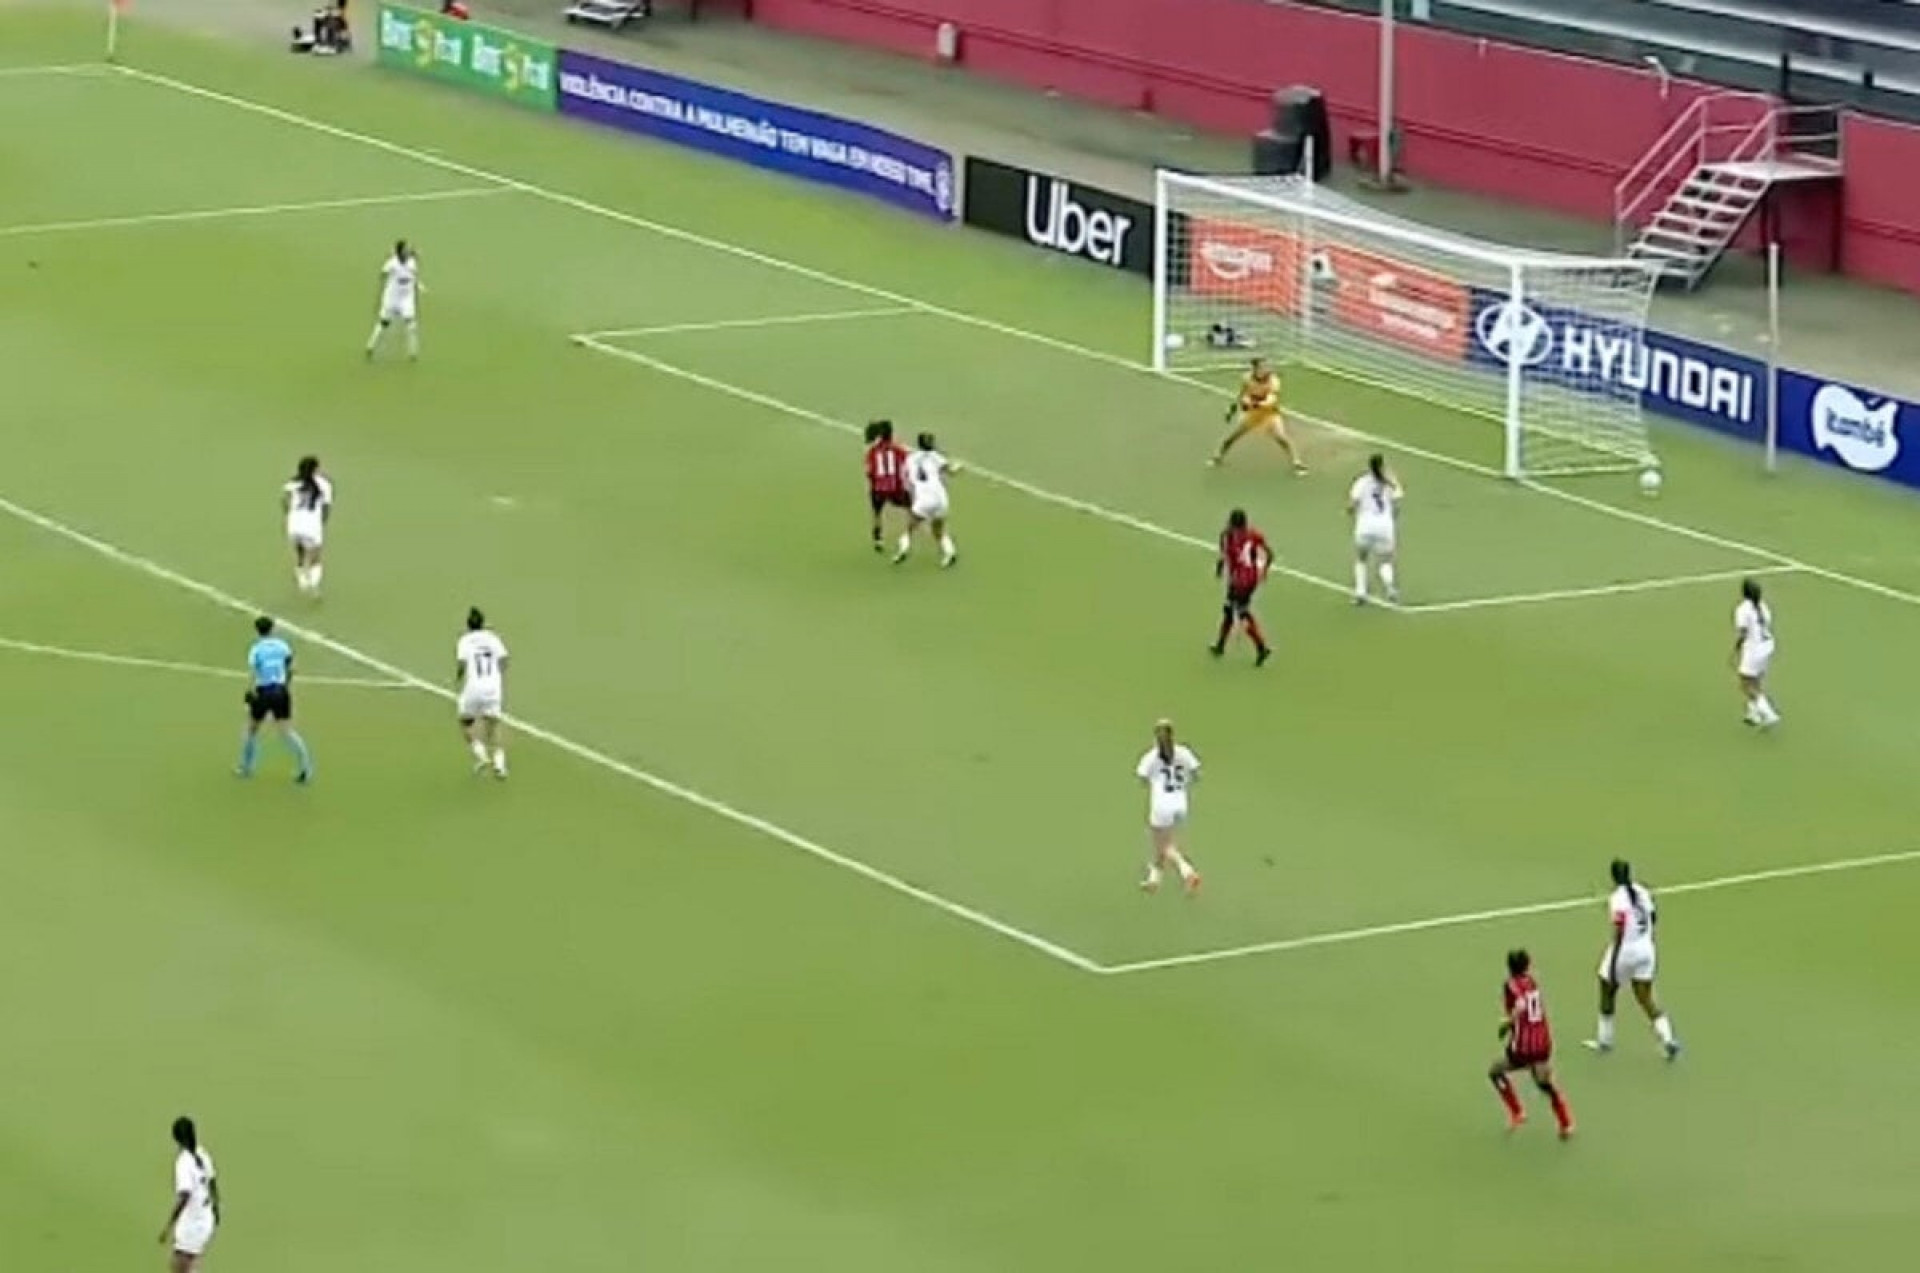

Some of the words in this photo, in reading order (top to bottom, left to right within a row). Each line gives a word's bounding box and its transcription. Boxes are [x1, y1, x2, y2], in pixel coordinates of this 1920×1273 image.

[1027, 174, 1131, 266] Uber
[1563, 325, 1752, 422] HYUNDAI
[876, 449, 896, 476] 11
